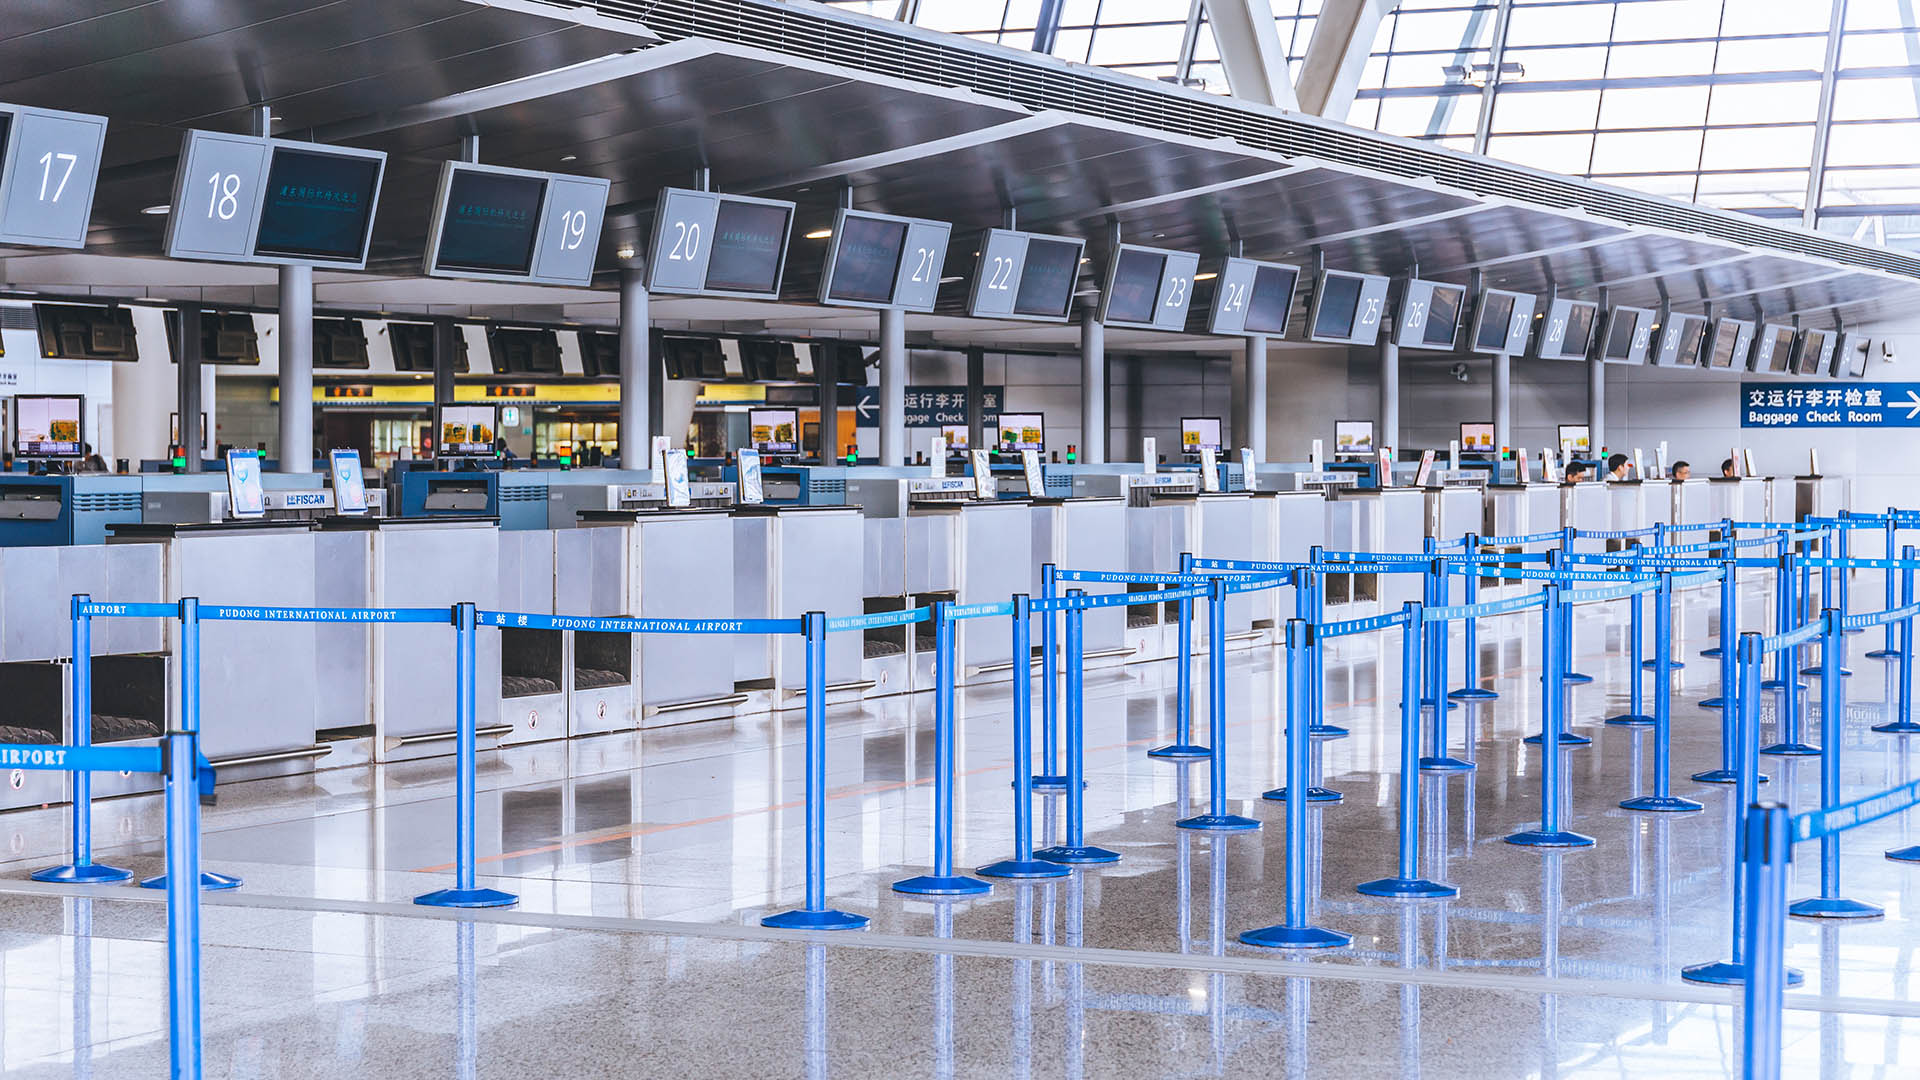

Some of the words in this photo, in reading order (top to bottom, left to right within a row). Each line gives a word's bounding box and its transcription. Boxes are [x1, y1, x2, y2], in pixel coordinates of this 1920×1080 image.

[40, 152, 76, 202] 17
[208, 172, 241, 220] 18
[560, 210, 586, 250] 19
[669, 221, 700, 261] 20
[911, 247, 935, 282] 21
[988, 256, 1013, 290] 22
[1165, 277, 1187, 308] 23
[1223, 283, 1245, 313] 24
[1361, 298, 1380, 325] 25
[1407, 302, 1424, 328] 26
[1512, 313, 1528, 338] 27
[1549, 318, 1563, 342] 28
[1635, 327, 1648, 349] 29
[1666, 328, 1678, 350] 30
[904, 393, 997, 409] 运行李开室
[1749, 388, 1882, 407] 交运行李开检室
[904, 413, 930, 424] ggage
[935, 412, 964, 422] Check
[983, 414, 997, 422] om
[1749, 411, 1799, 424] Baggage
[1806, 411, 1841, 422] Check
[1848, 411, 1882, 422] Room
[296, 494, 325, 505] FISCAN
[1602, 557, 1634, 565] PUDONG
[1101, 574, 1136, 582] PUDONG
[1521, 570, 1556, 578] PUDONG
[1559, 572, 1630, 580] INTERNATIONAL
[82, 605, 127, 614] AIRPORT
[219, 608, 260, 618] PUDONG
[265, 610, 347, 620] INTERNATIONAL
[351, 611, 397, 620] AIRPORT
[551, 618, 596, 629] PUDONG
[600, 620, 690, 631] INTERNATIONAL
[694, 622, 743, 631] AIRPORT
[0, 749, 67, 766] IRPORT
